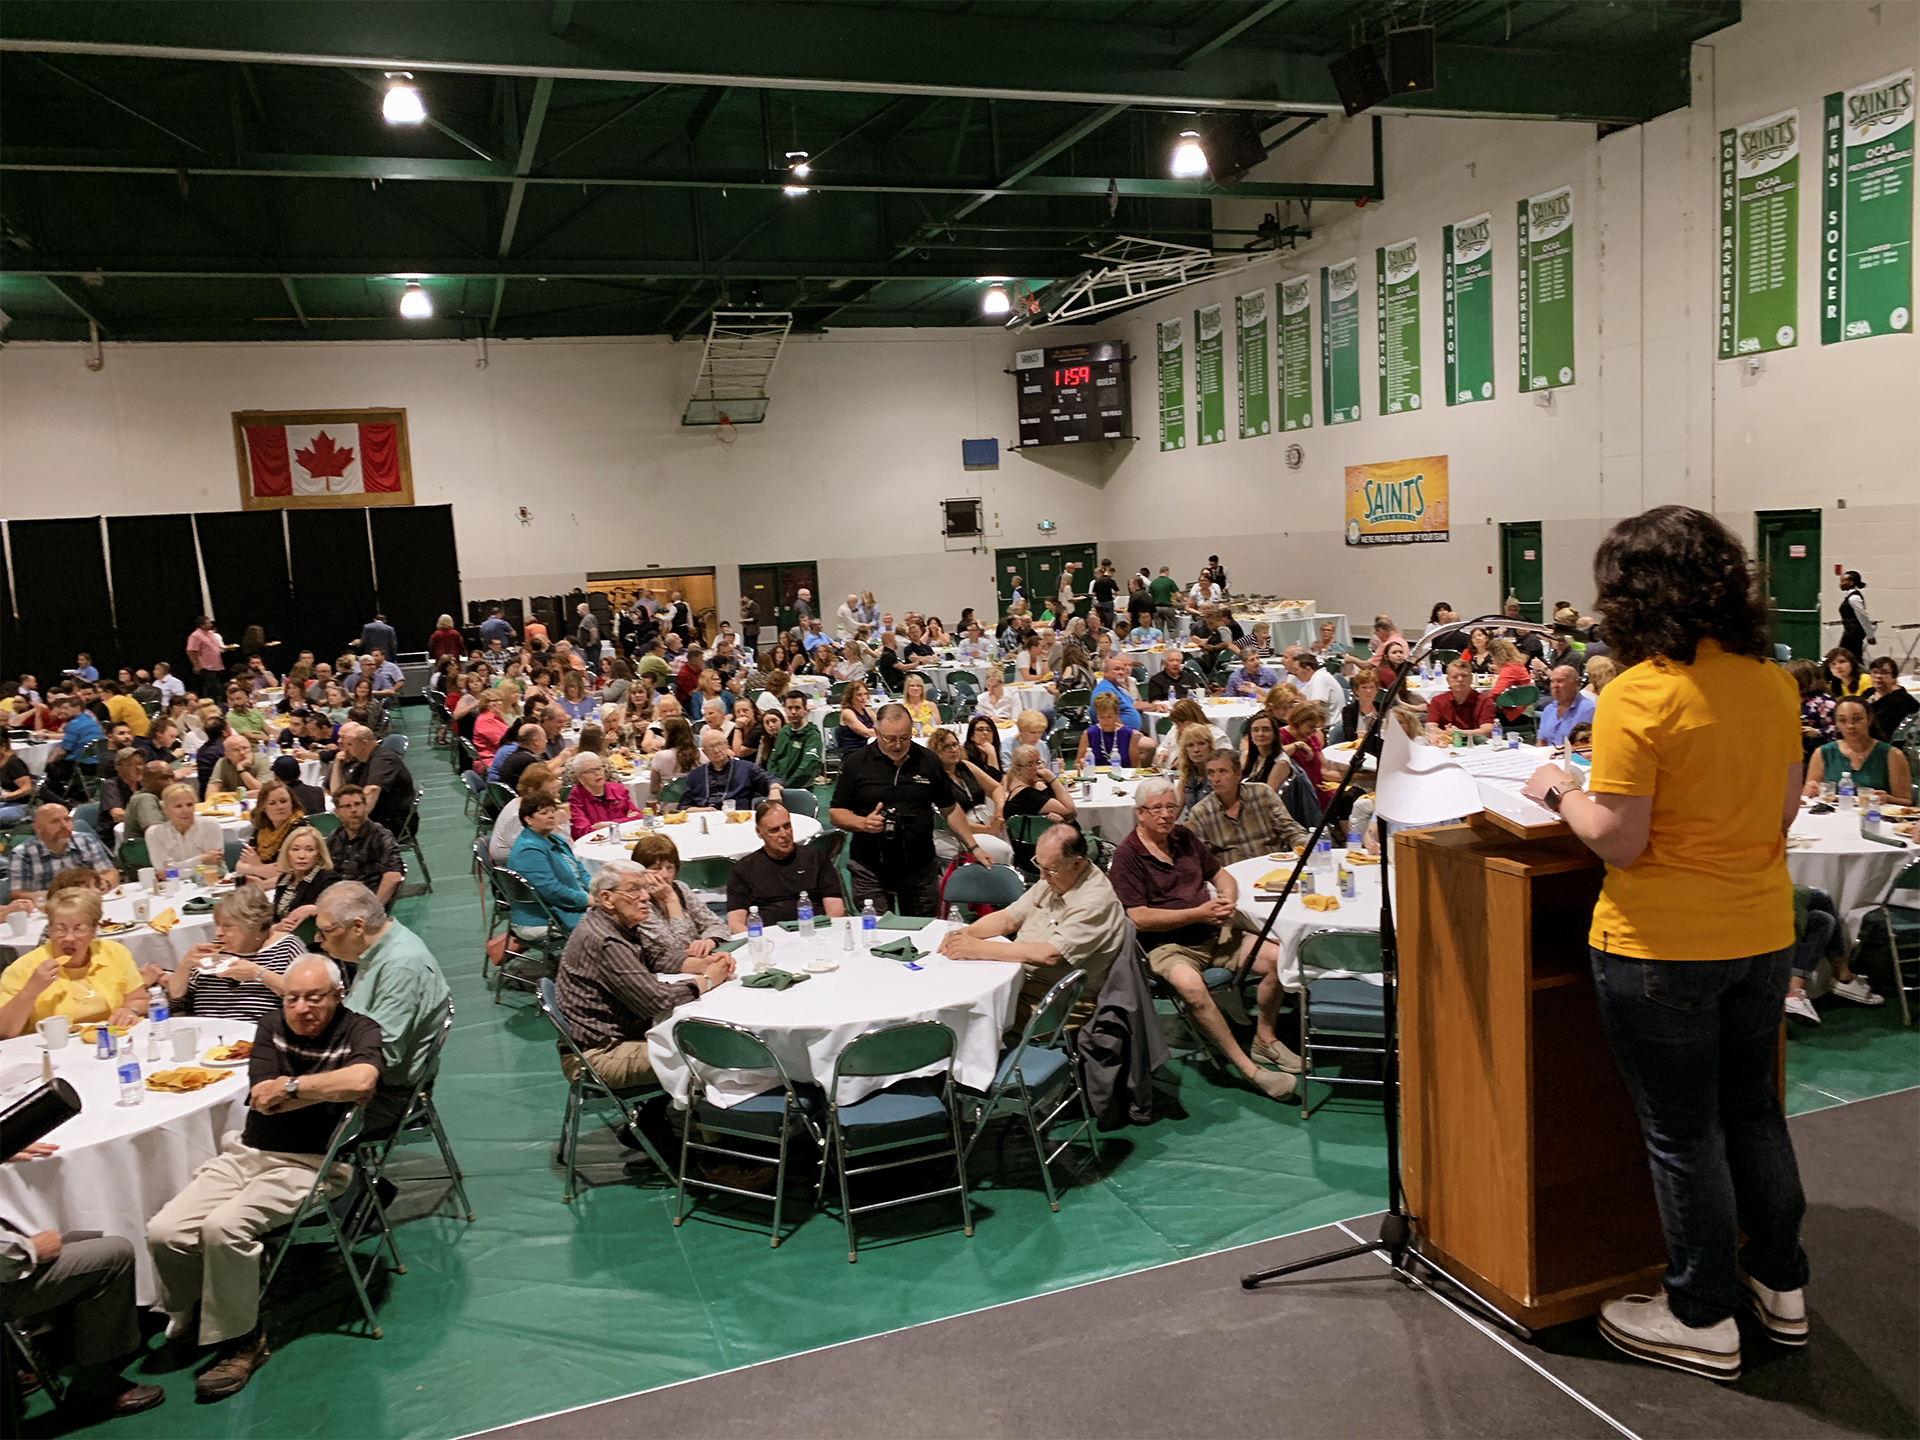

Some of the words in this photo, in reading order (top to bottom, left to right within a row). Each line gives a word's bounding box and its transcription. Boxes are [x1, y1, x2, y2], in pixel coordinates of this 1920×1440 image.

[1848, 78, 1911, 125] SAINTS
[1741, 115, 1796, 160] SAINTS
[1827, 115, 1840, 187] MENS
[1865, 142, 1895, 159] OCAA
[1722, 134, 1735, 211] WOMENS
[1531, 190, 1570, 226] SAINTS
[1519, 214, 1527, 257] MENS
[1826, 211, 1839, 318] SOCCER
[1446, 253, 1455, 364] BADMINTON
[1721, 226, 1733, 351] BASKETBALL
[1378, 274, 1386, 376] BADMINTON
[1520, 270, 1528, 376] BASKETBALL
[1054, 366, 1090, 386] 11:59
[1096, 377, 1116, 386] GUEST
[1363, 473, 1424, 520] SAINTS
